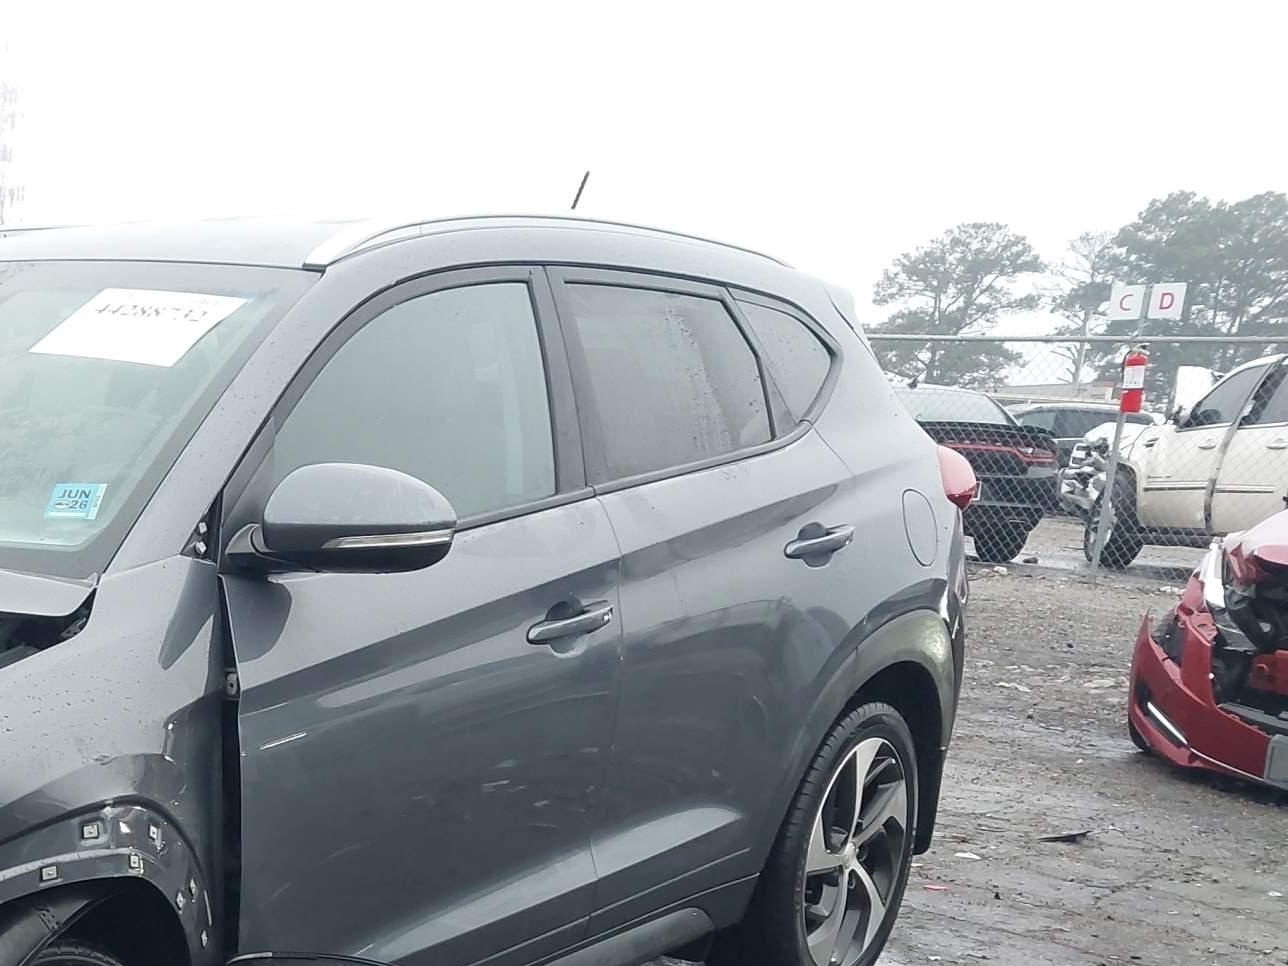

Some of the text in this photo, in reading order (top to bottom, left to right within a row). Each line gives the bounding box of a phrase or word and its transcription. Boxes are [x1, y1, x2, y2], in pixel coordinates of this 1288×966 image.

[1119, 293, 1134, 312] C
[1159, 292, 1175, 311] D
[57, 488, 92, 500] JUN
